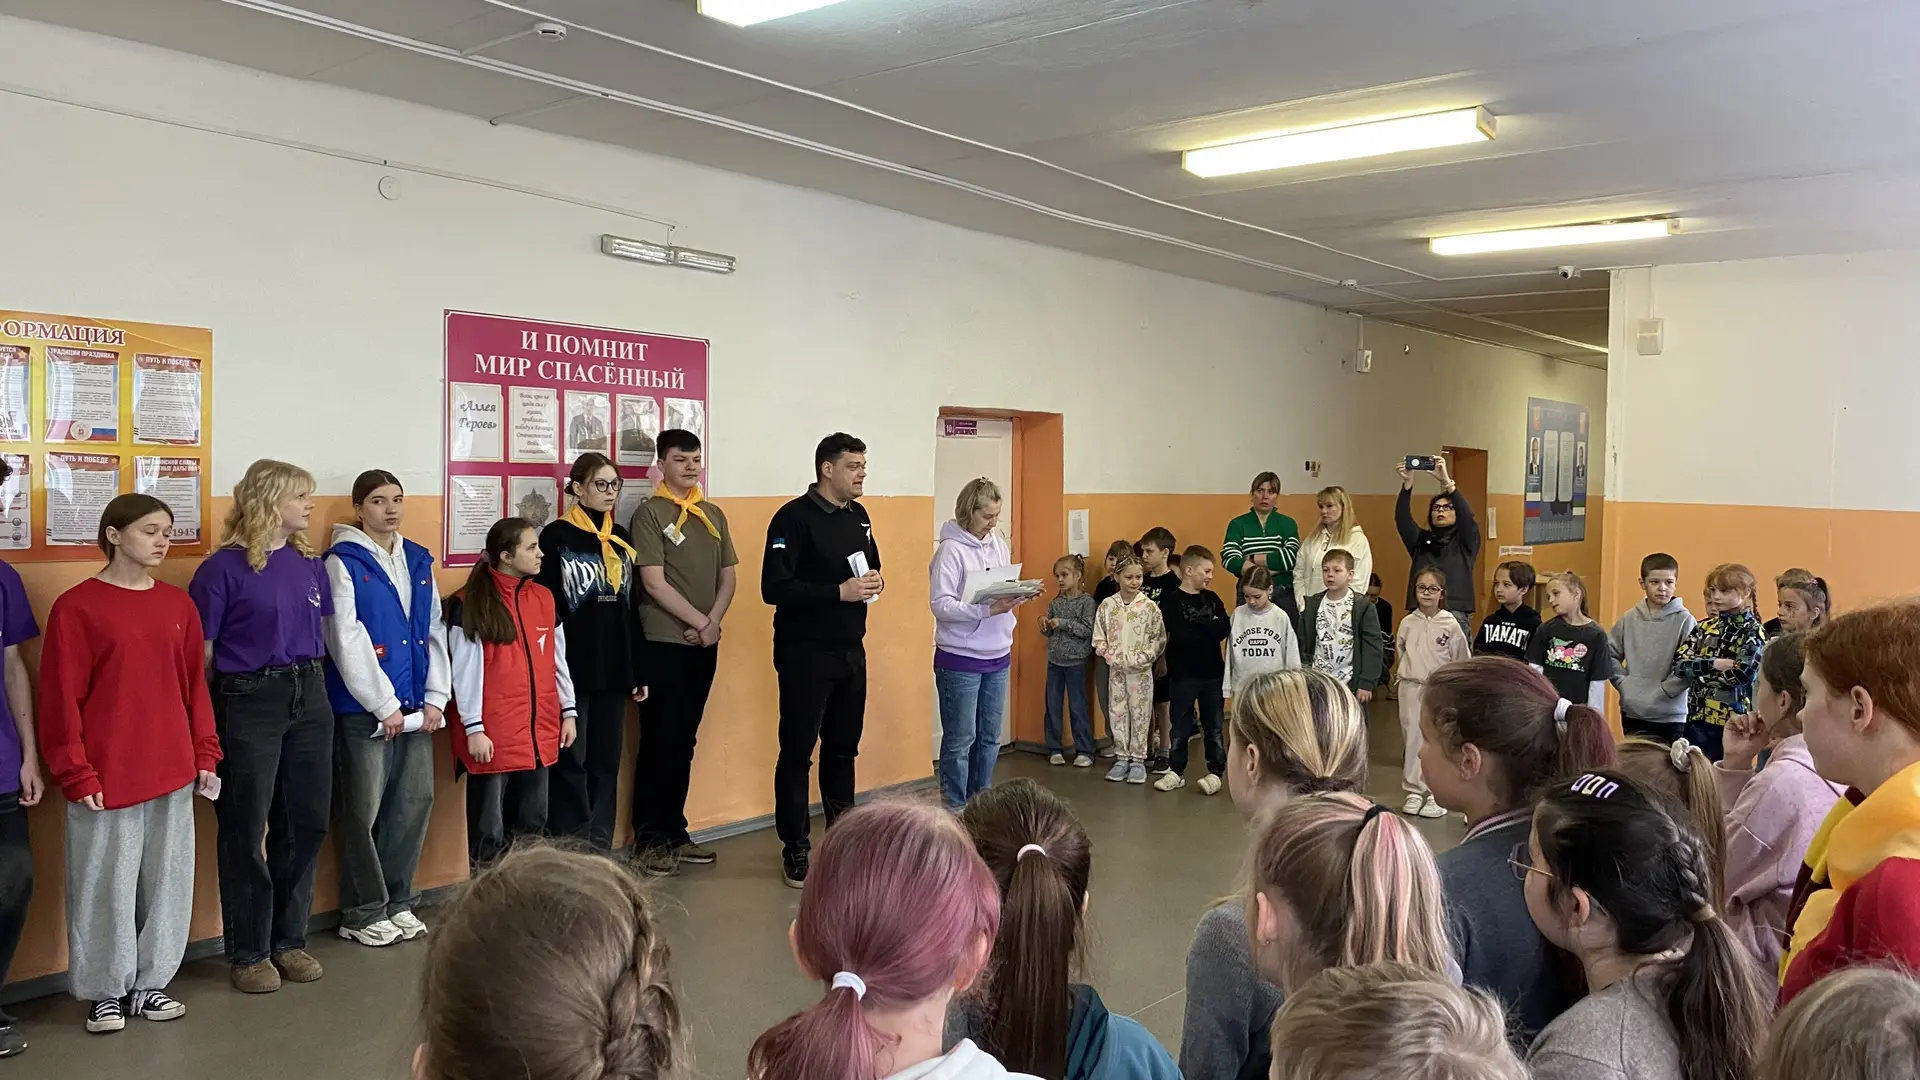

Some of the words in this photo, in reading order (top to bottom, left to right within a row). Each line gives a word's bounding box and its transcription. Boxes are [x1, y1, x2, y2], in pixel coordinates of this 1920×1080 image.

[0, 320, 125, 346] ОРМАЦИЯ
[520, 330, 539, 351] И
[545, 333, 648, 361] ПОМНИТ
[474, 353, 531, 377] МИР
[538, 360, 685, 390] СПАСЁННЫЙ
[460, 400, 496, 412] «Аллея
[459, 417, 497, 432] Героев»
[60, 454, 77, 462] ПУТЬ
[83, 456, 109, 464] ПОБЕДЕ
[1235, 626, 1262, 645] CHOOSE
[1263, 627, 1274, 637] TO
[1242, 648, 1276, 657] TODAY
